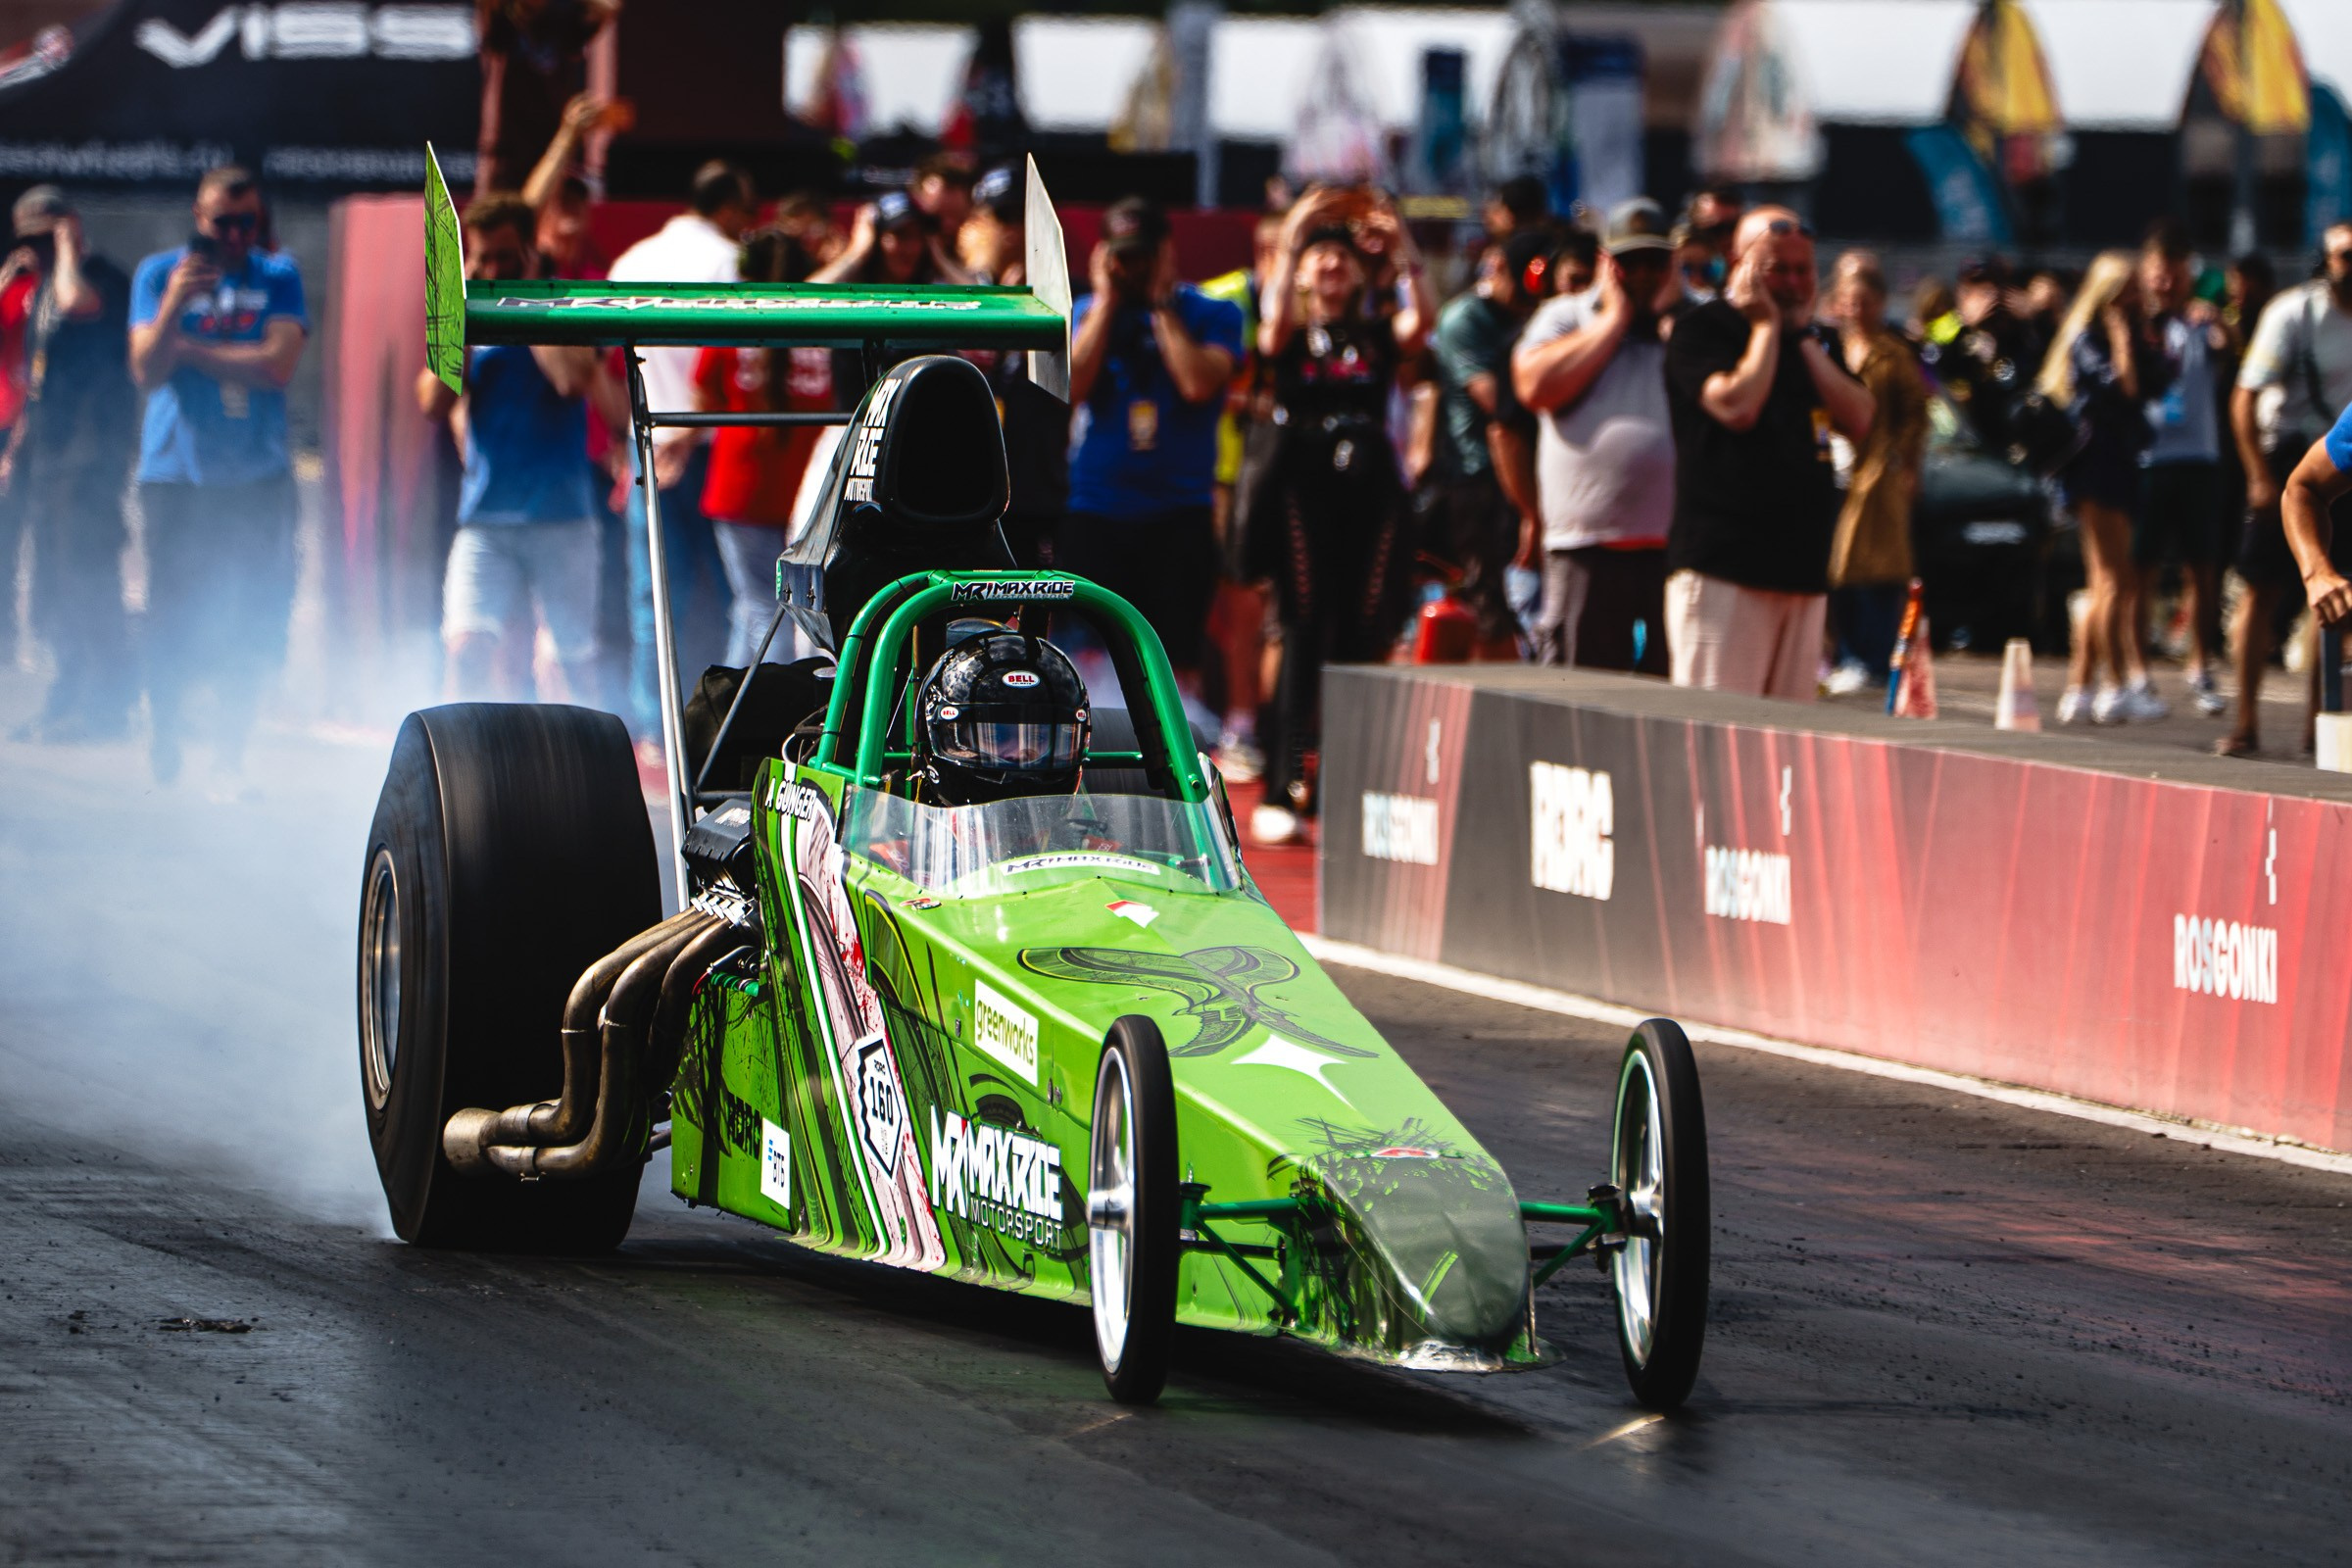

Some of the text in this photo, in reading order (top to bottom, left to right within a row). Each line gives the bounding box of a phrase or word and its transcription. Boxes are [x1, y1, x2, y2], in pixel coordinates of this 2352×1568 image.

[765, 777, 776, 808] A
[1705, 846, 1791, 925] ROSGONKI
[2174, 912, 2278, 1004] ROSGONKI
[977, 1000, 1034, 1066] greenworks
[870, 1076, 894, 1126] 160
[970, 1197, 1062, 1250] MOTORSPORT
